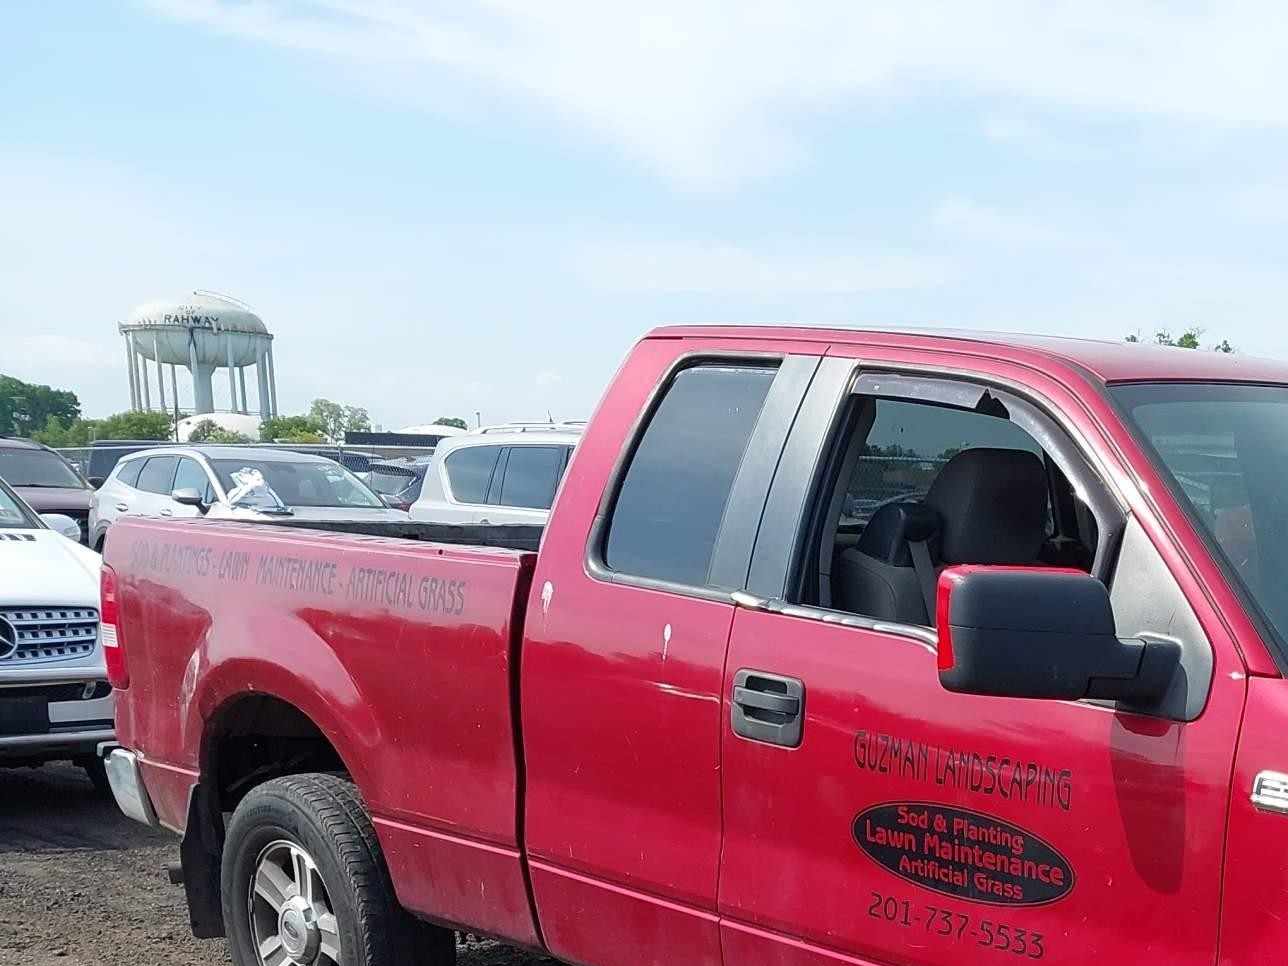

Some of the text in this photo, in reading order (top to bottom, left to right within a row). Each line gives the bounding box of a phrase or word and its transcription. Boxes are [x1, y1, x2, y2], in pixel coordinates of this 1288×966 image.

[164, 314, 218, 326] RAHWAY
[217, 550, 251, 581] LAWN
[256, 554, 338, 595] MAINTENANCE
[346, 566, 415, 609] ARTIFICIAL
[418, 576, 466, 615] GRASS
[854, 730, 1072, 811] GUZMAN LANDSCAPING
[866, 819, 1065, 887] Lawn Maintenance
[897, 806, 1025, 854] Sod & Planting
[899, 853, 1024, 900] Artificial Grass
[867, 891, 1046, 960] 201-737-5533
